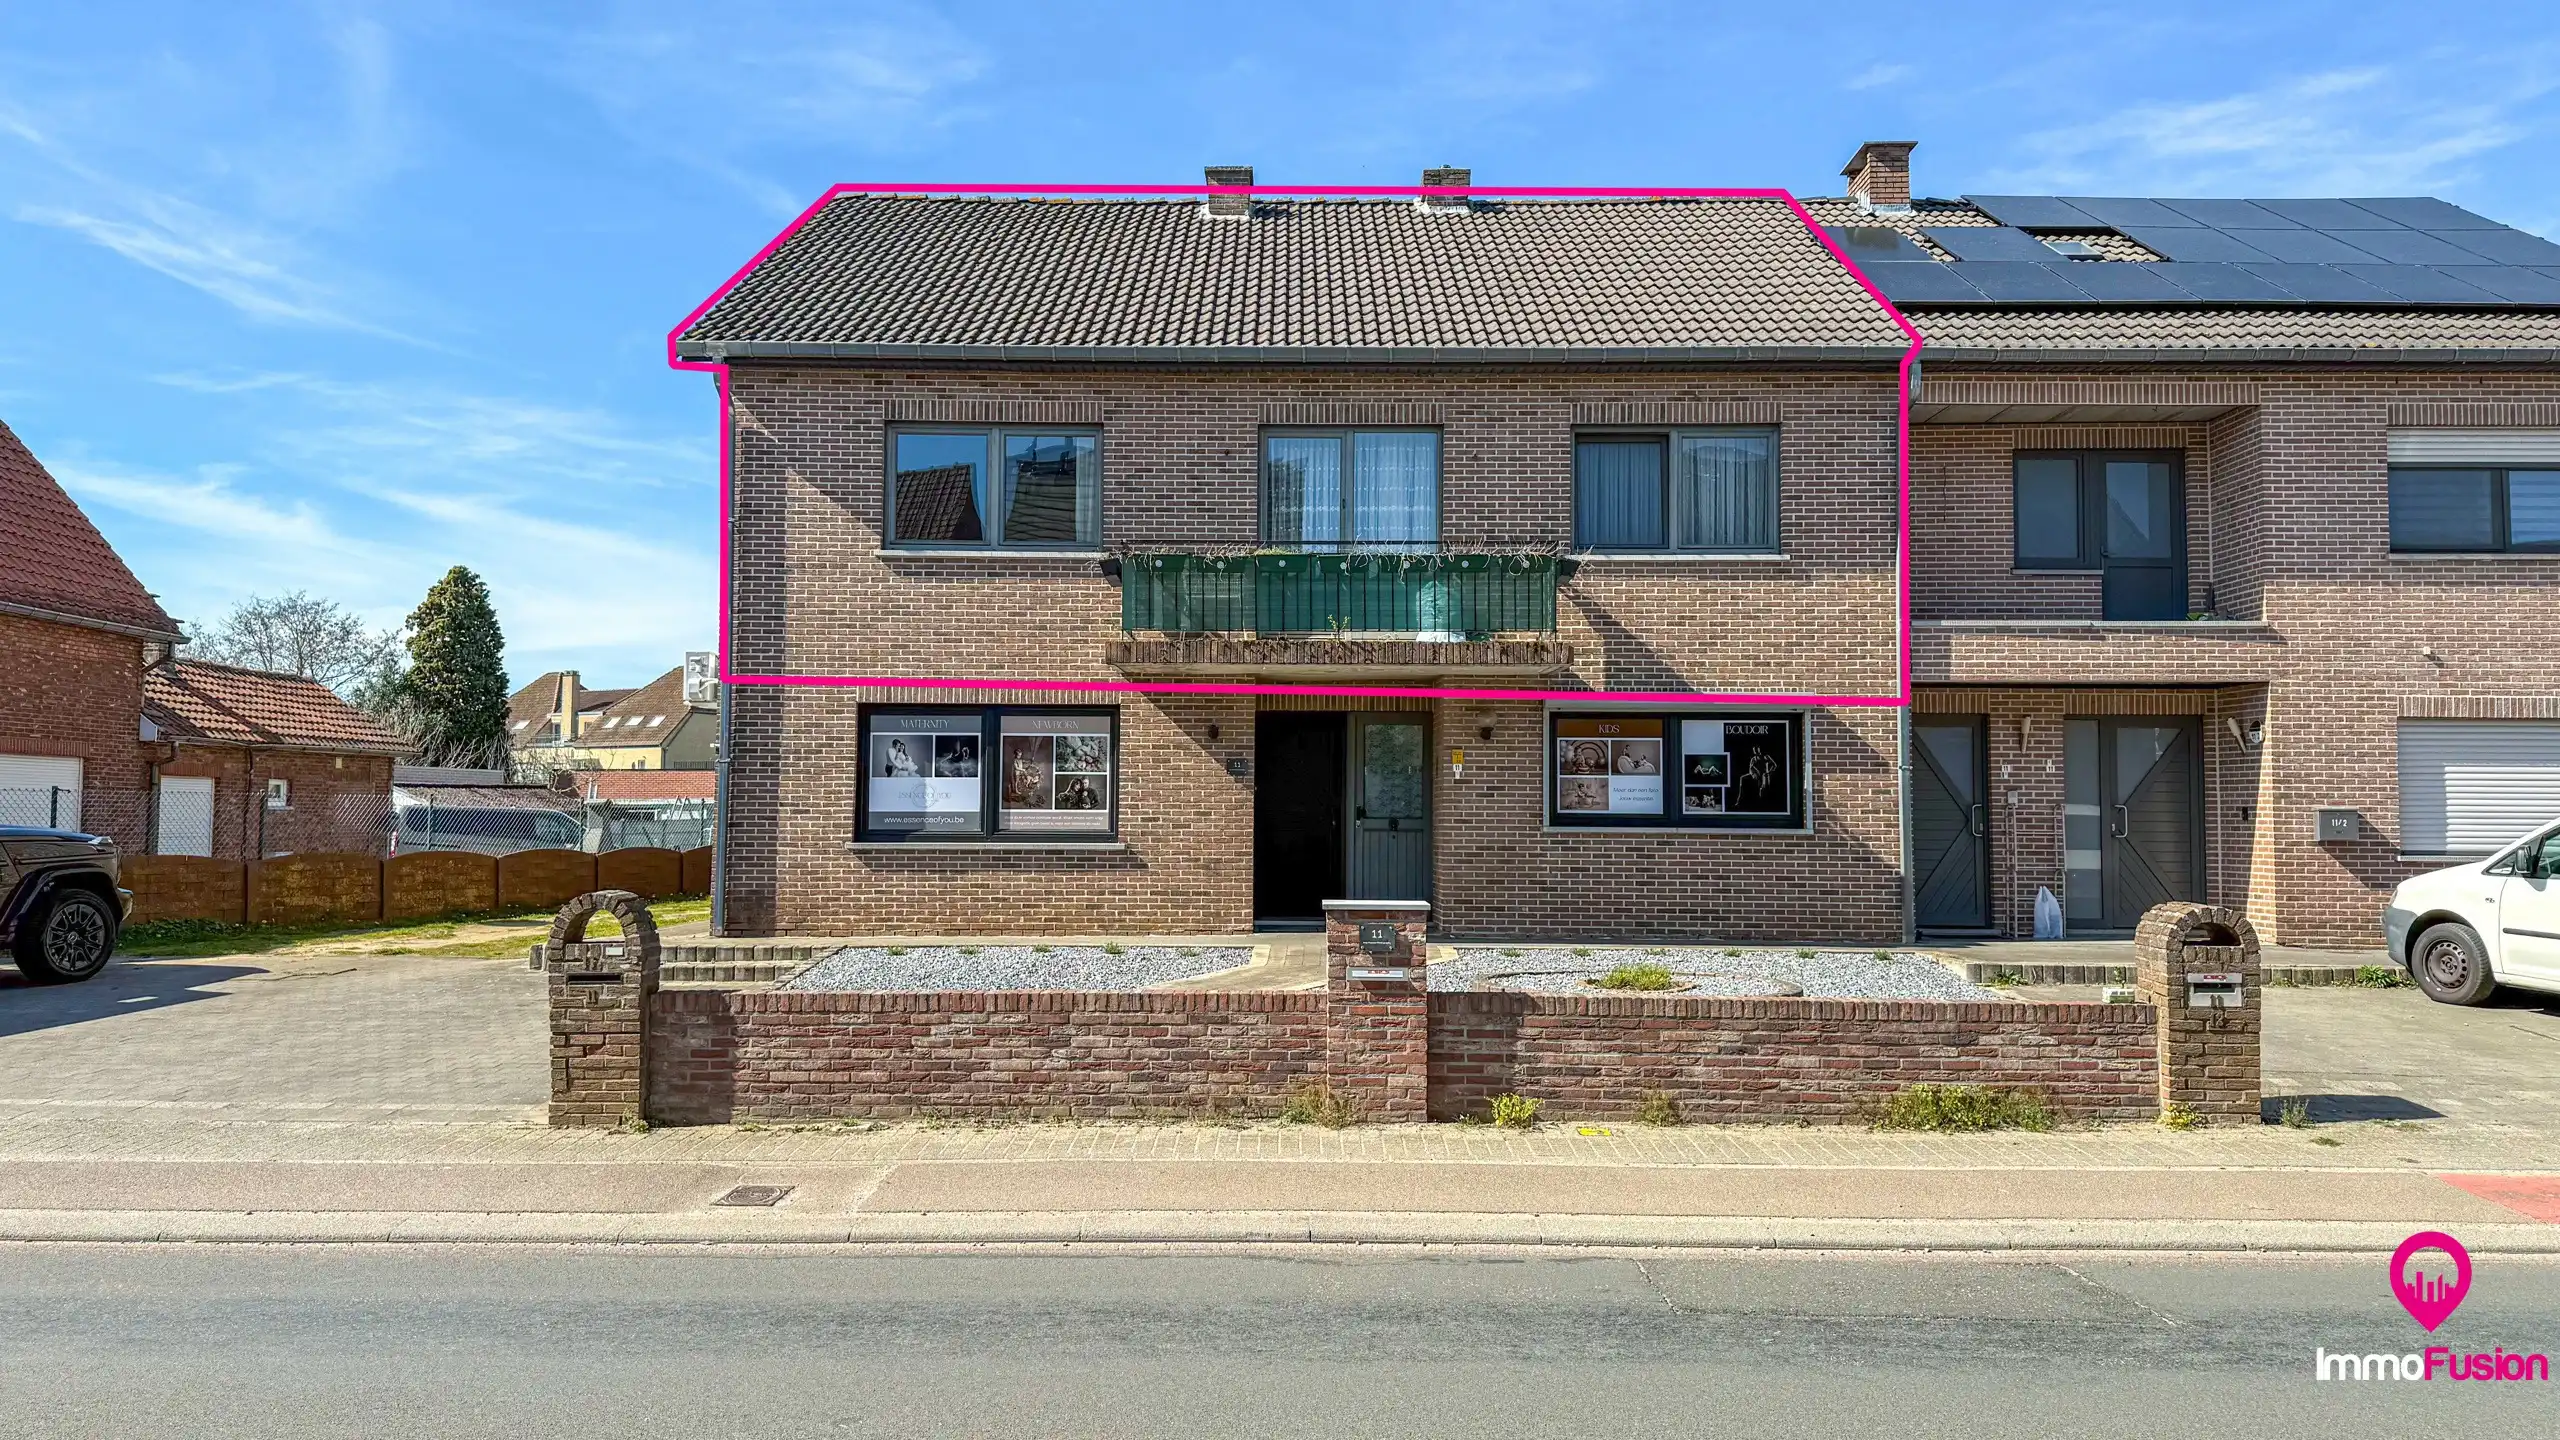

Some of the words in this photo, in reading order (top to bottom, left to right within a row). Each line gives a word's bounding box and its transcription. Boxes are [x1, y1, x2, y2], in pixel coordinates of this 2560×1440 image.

[901, 719, 949, 729] MATERNITY
[1032, 720, 1079, 730] NEWBORN
[1598, 724, 1620, 734] KIDS
[1726, 725, 1769, 735] BOUDOIR
[884, 815, 965, 825] www.essenceofyou.be
[2331, 819, 2348, 827] 11/2
[1371, 929, 1383, 939] 11
